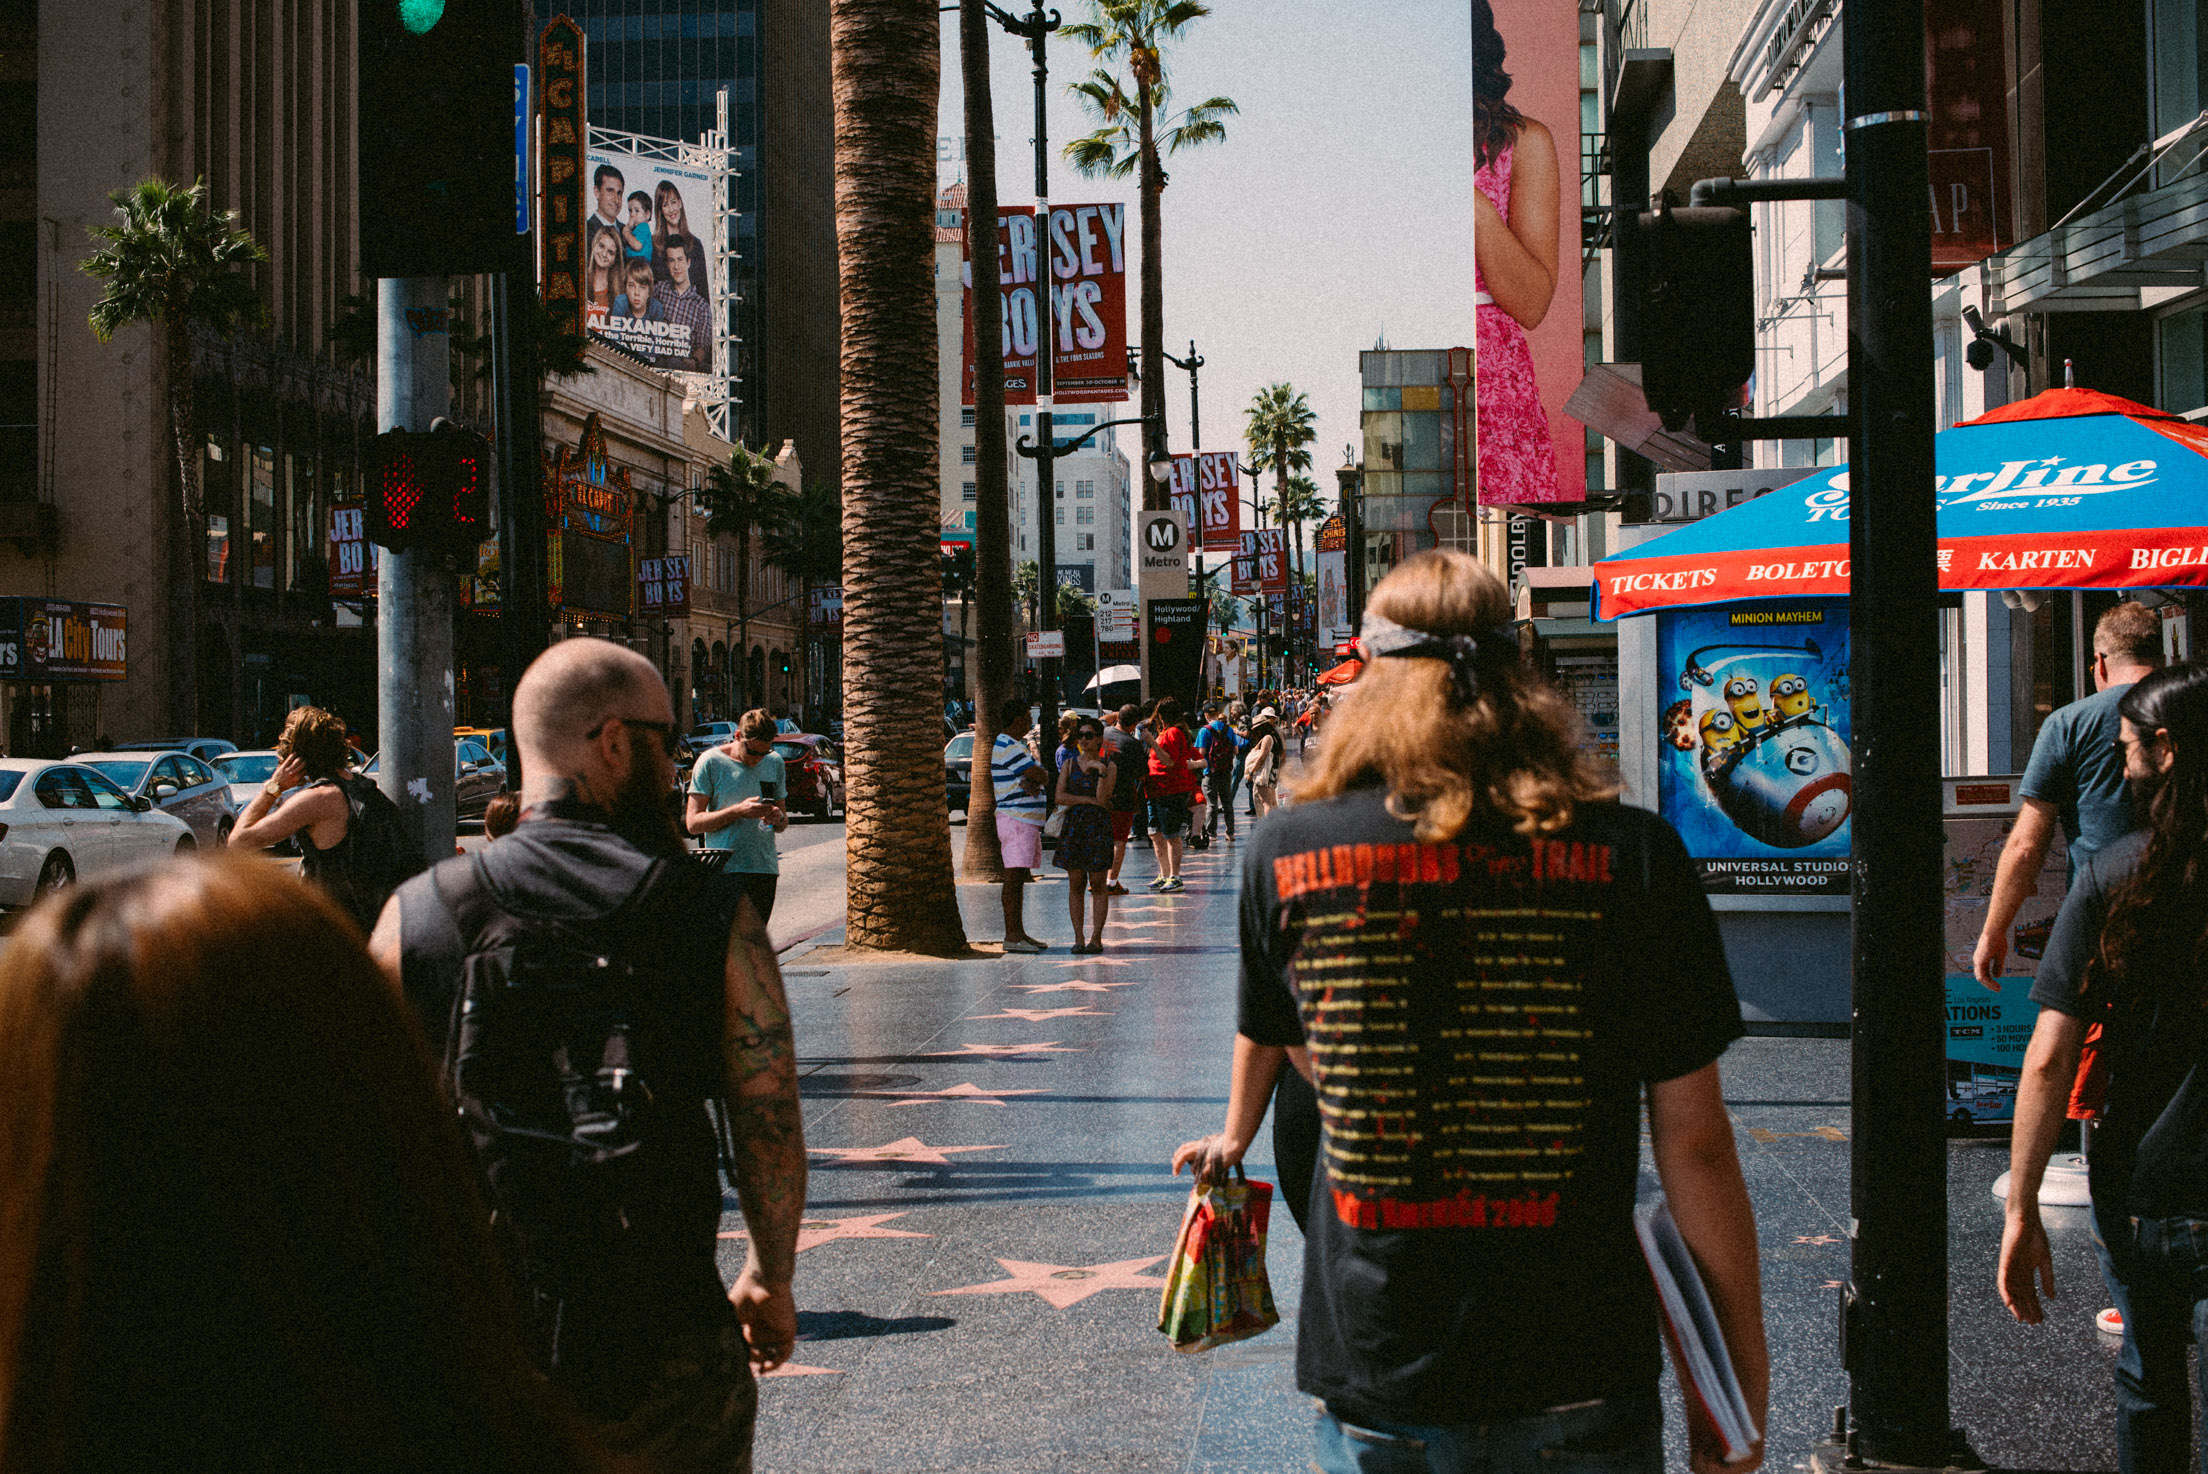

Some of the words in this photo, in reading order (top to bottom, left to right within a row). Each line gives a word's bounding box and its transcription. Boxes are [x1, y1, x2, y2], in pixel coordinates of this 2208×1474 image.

[546, 42, 577, 72] EL
[586, 153, 612, 165] CARELL
[653, 166, 683, 177] JENNIFER
[684, 170, 709, 182] GARNER
[587, 313, 691, 340] ALEXANDER
[605, 330, 619, 341] the
[620, 333, 654, 345] Terrible,
[655, 338, 691, 349] Horrible,
[654, 345, 672, 356] BAD
[674, 348, 691, 357] DAY
[1060, 355, 1070, 363] THE
[1070, 353, 1082, 362] FOUR
[1083, 351, 1105, 361] SEASONS
[1003, 360, 1021, 369] RANKIE
[1055, 388, 1128, 396] HOLLYWOODPANTAGES.COM
[1651, 488, 1772, 519] DIRE
[1975, 498, 2028, 511] Since
[2033, 496, 2082, 508] 1935
[1510, 513, 1526, 576] DOLBY
[1144, 556, 1181, 567] Metro
[1977, 549, 2097, 571] KARTEN
[638, 555, 689, 582] JERSEY
[1057, 574, 1081, 586] KINGS
[1610, 568, 1718, 595] TICKETS
[645, 579, 684, 605] BOYS
[1154, 605, 1201, 614] Hollywood/
[1154, 615, 1191, 625] Highland
[1731, 612, 1773, 624] MINION
[1775, 611, 1822, 623] MAYHEM
[48, 617, 64, 658] LA
[64, 614, 90, 664] City
[90, 619, 126, 662] Tours
[1027, 634, 1038, 642] NO
[1530, 838, 1613, 883] TRAIL
[1706, 862, 1789, 872] UNIVERSAL
[1735, 875, 1828, 886] HOLLYWOOD
[1954, 996, 1966, 1004] Los
[1966, 996, 1991, 1005] Angeles
[1996, 1025, 2002, 1033] 3
[2003, 1024, 2032, 1033] HOURS
[1997, 1035, 2007, 1043] 50
[1997, 1044, 2010, 1052] 100
